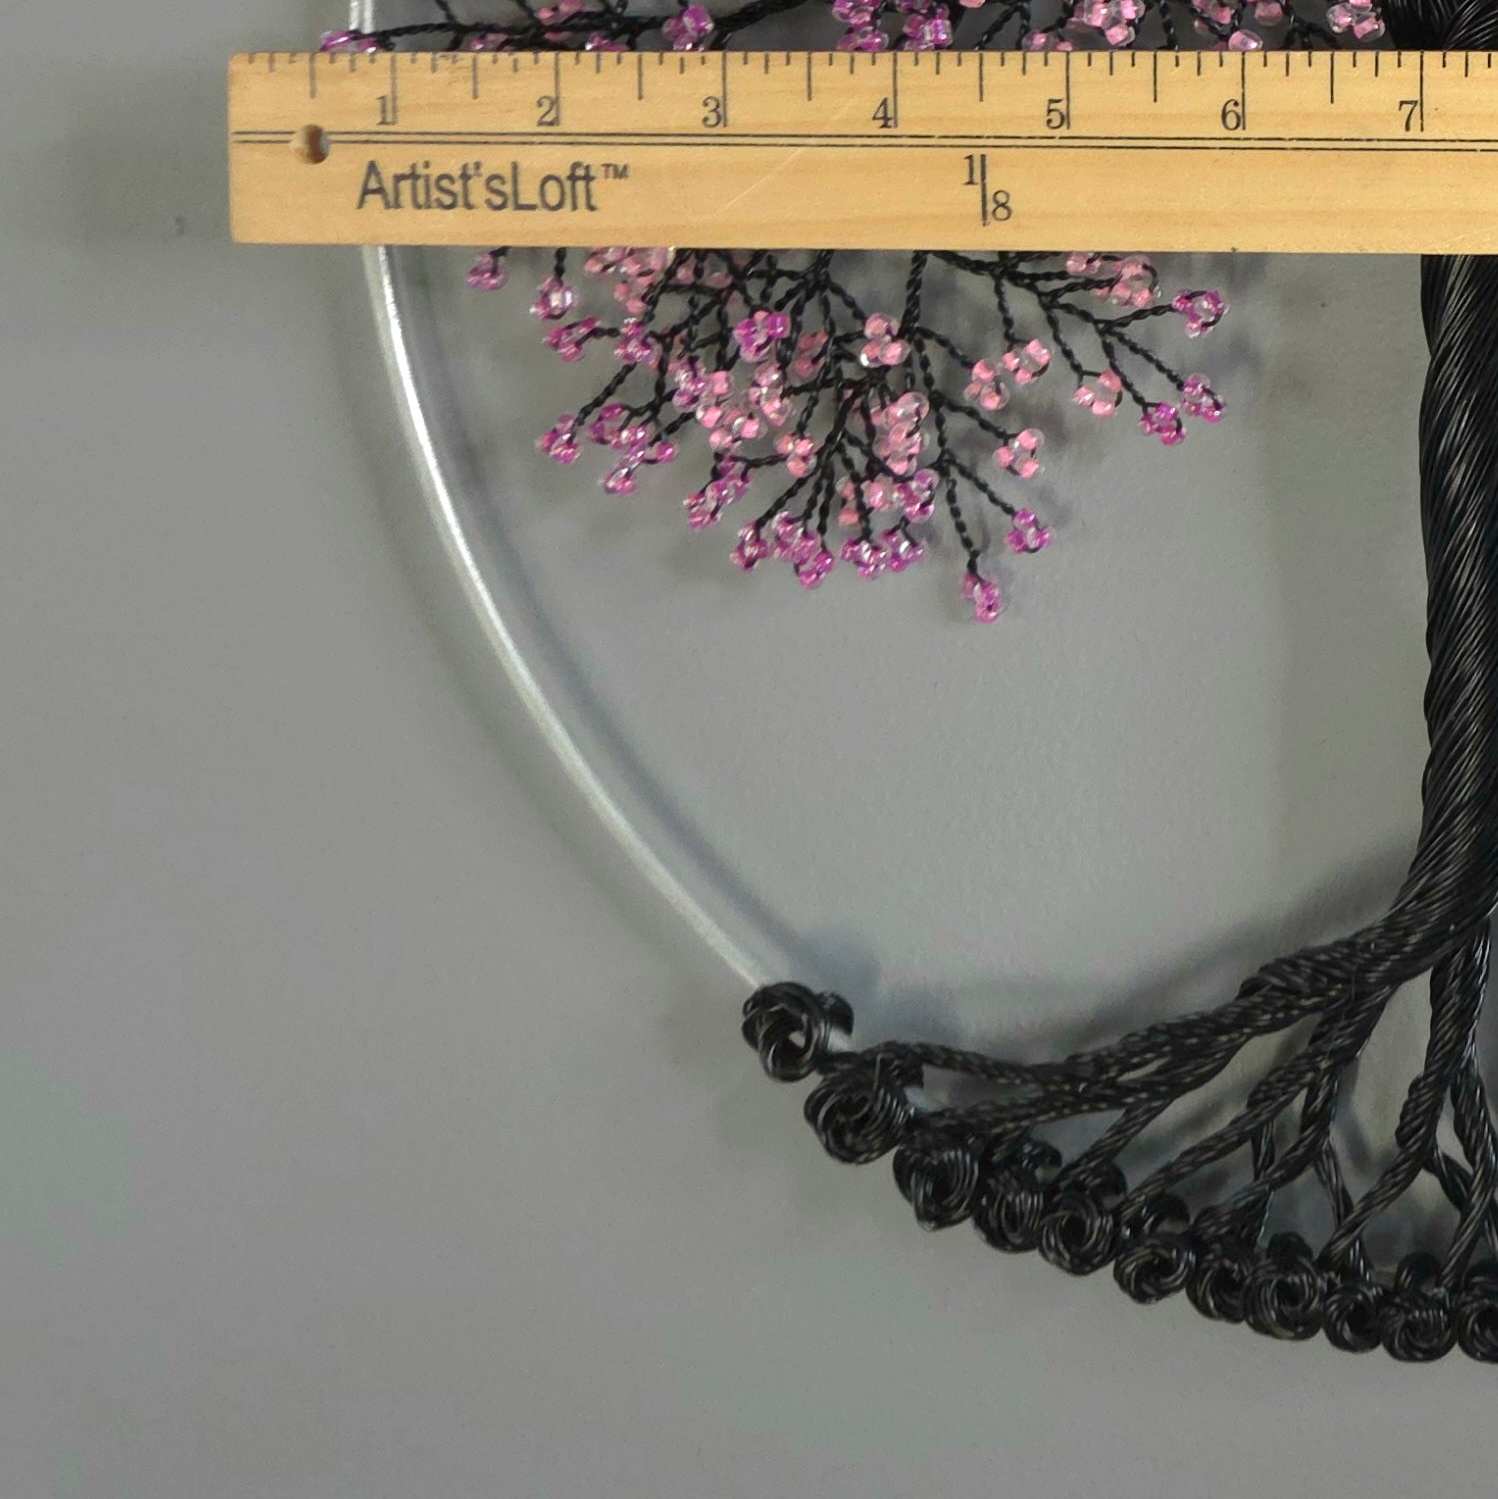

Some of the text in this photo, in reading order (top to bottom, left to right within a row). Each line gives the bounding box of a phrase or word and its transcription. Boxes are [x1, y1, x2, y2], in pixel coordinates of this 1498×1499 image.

[376, 95, 391, 126] 1
[537, 96, 557, 126] 2
[702, 97, 722, 128] 3
[872, 98, 893, 128] 4
[1046, 99, 1065, 130] 5
[1221, 99, 1241, 131] 6
[1399, 100, 1418, 132] 7
